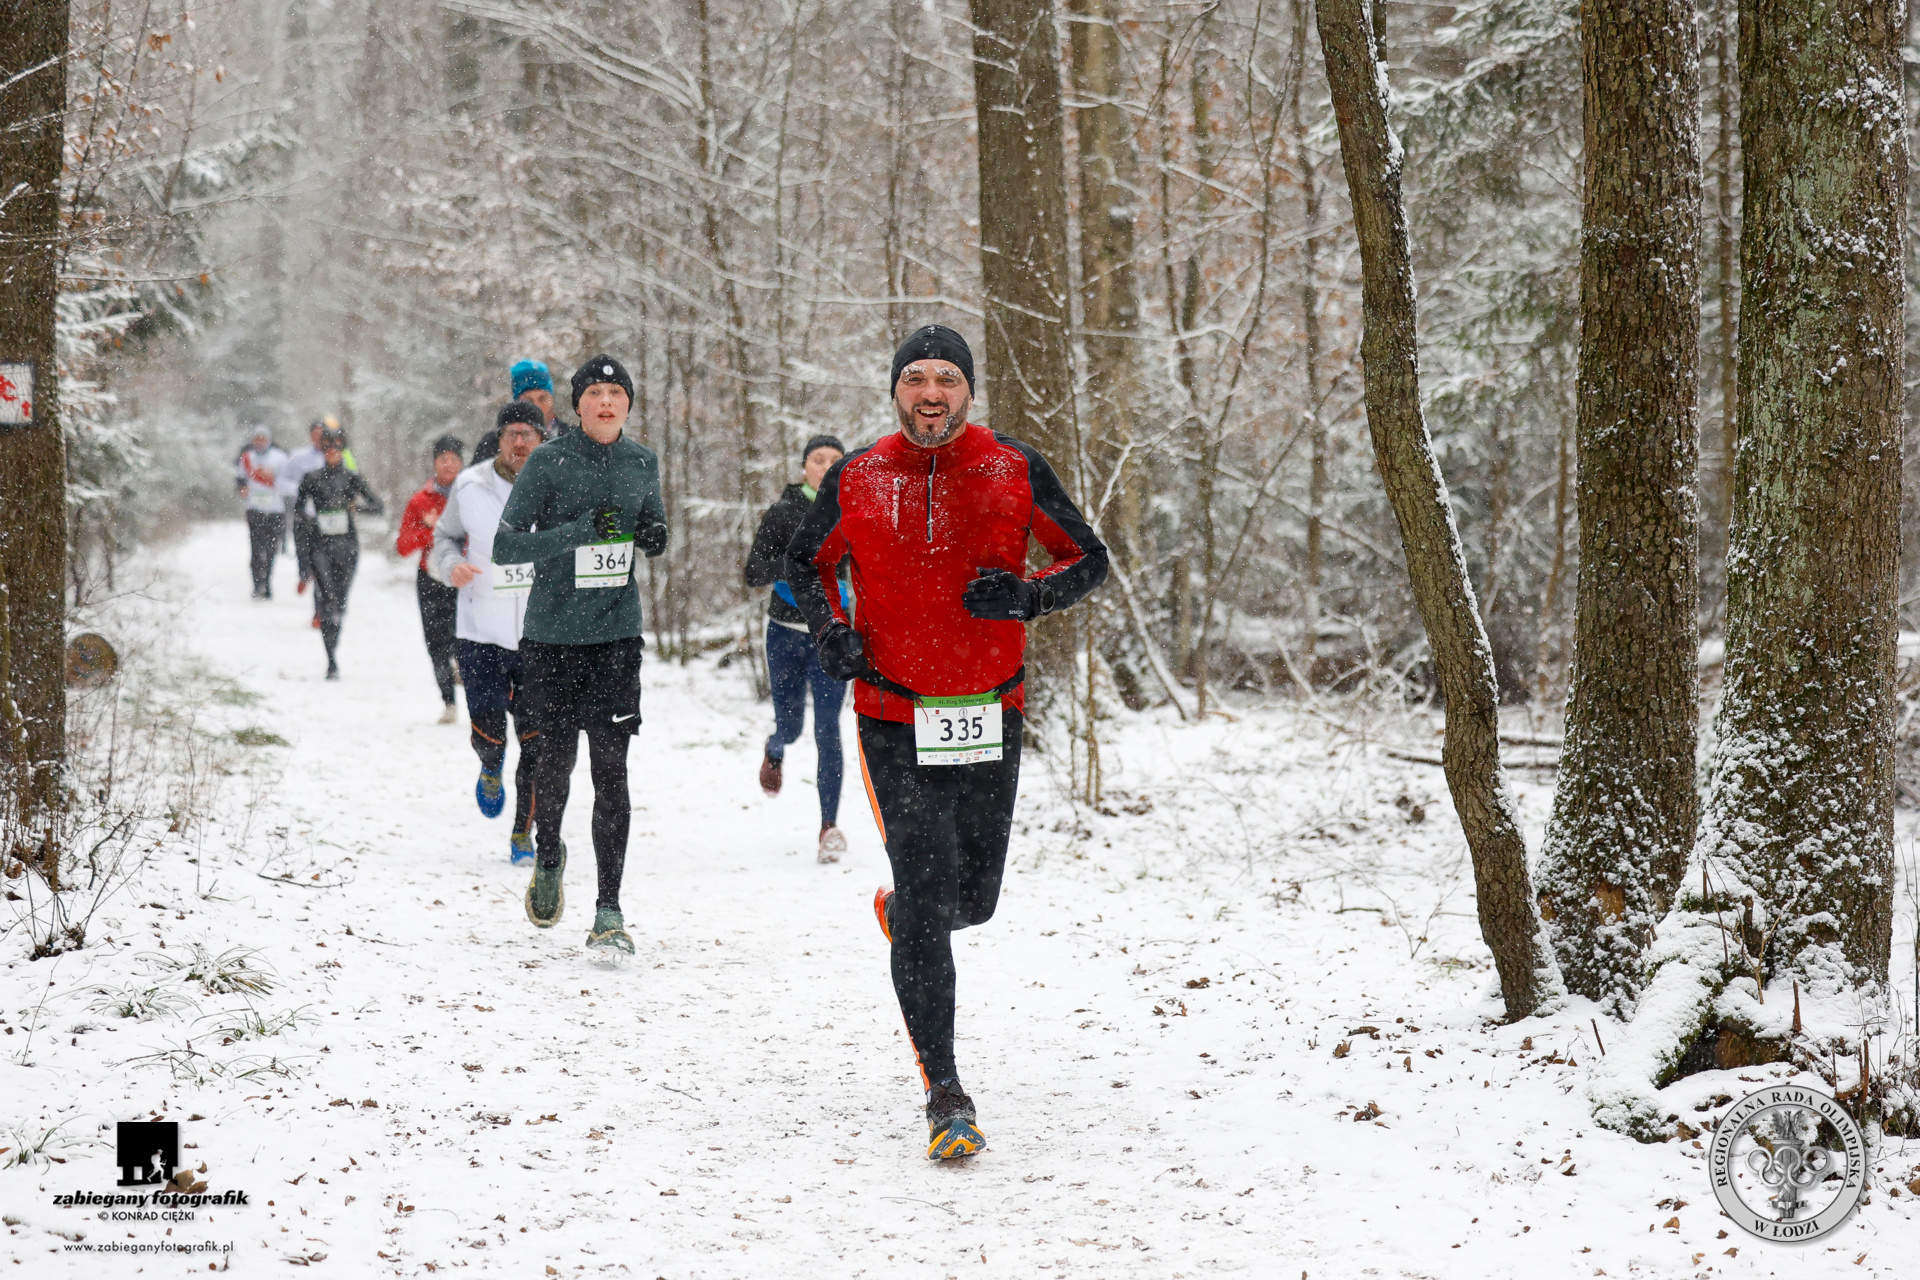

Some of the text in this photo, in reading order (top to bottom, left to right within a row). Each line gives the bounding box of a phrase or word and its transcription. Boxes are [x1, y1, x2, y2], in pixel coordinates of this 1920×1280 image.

[594, 552, 627, 572] 364
[504, 566, 536, 583] 554
[939, 716, 983, 742] 335
